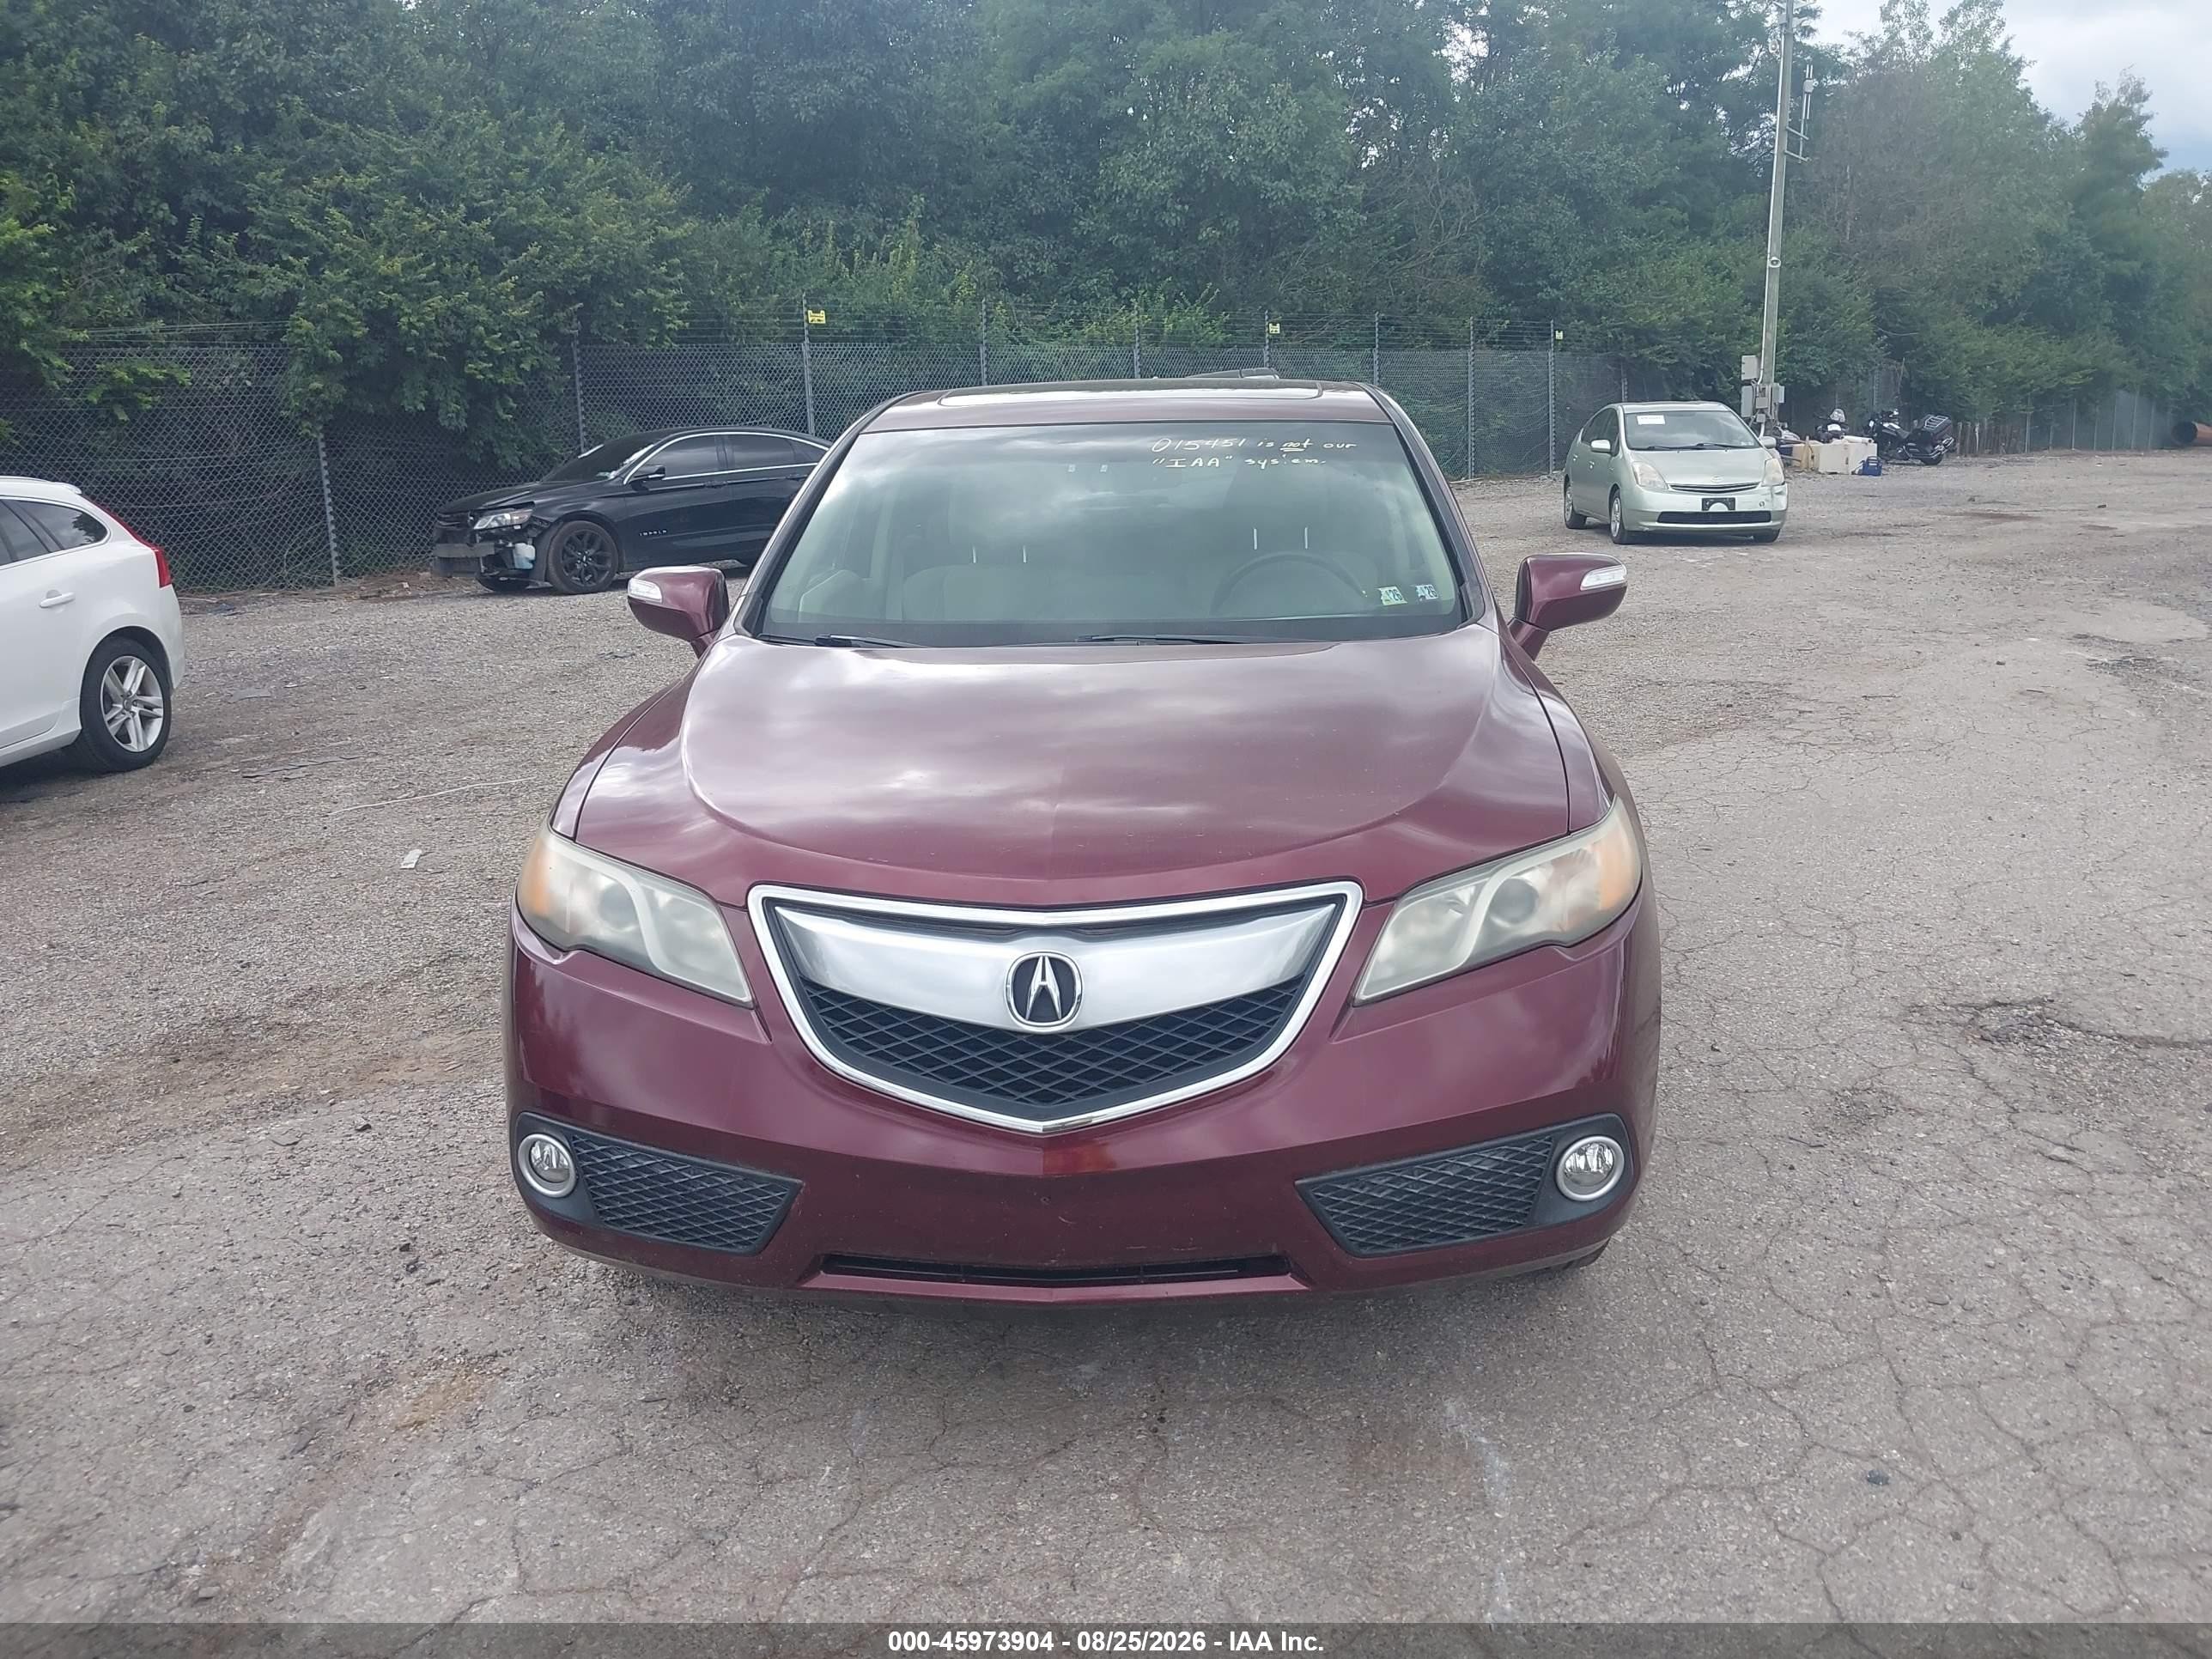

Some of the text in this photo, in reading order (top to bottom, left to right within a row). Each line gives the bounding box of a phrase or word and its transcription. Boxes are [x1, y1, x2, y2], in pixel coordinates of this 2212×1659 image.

[1152, 438, 1247, 453] 015451
[1257, 438, 1274, 447] is
[1280, 438, 1314, 450] not
